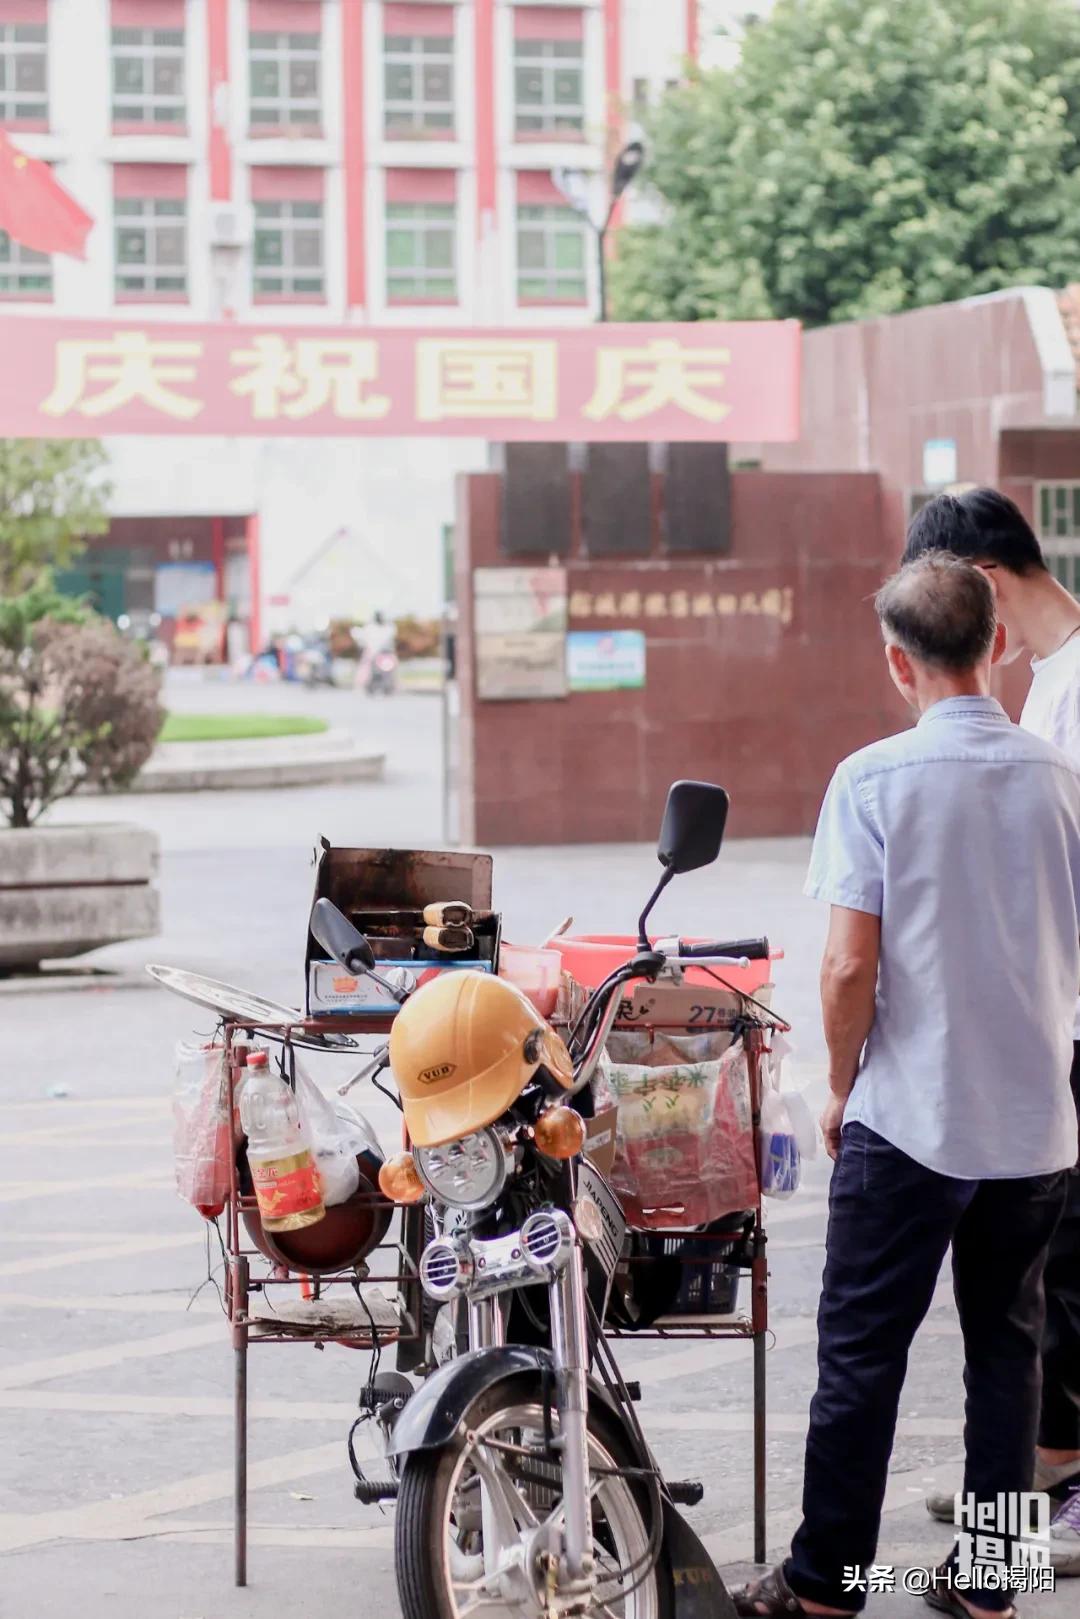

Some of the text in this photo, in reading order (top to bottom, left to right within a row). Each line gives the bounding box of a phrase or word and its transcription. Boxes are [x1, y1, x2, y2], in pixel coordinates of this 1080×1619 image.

[39, 332, 732, 423] 庆祝国庆
[688, 1004, 716, 1023] 27
[583, 1179, 619, 1237] JIAPENG
